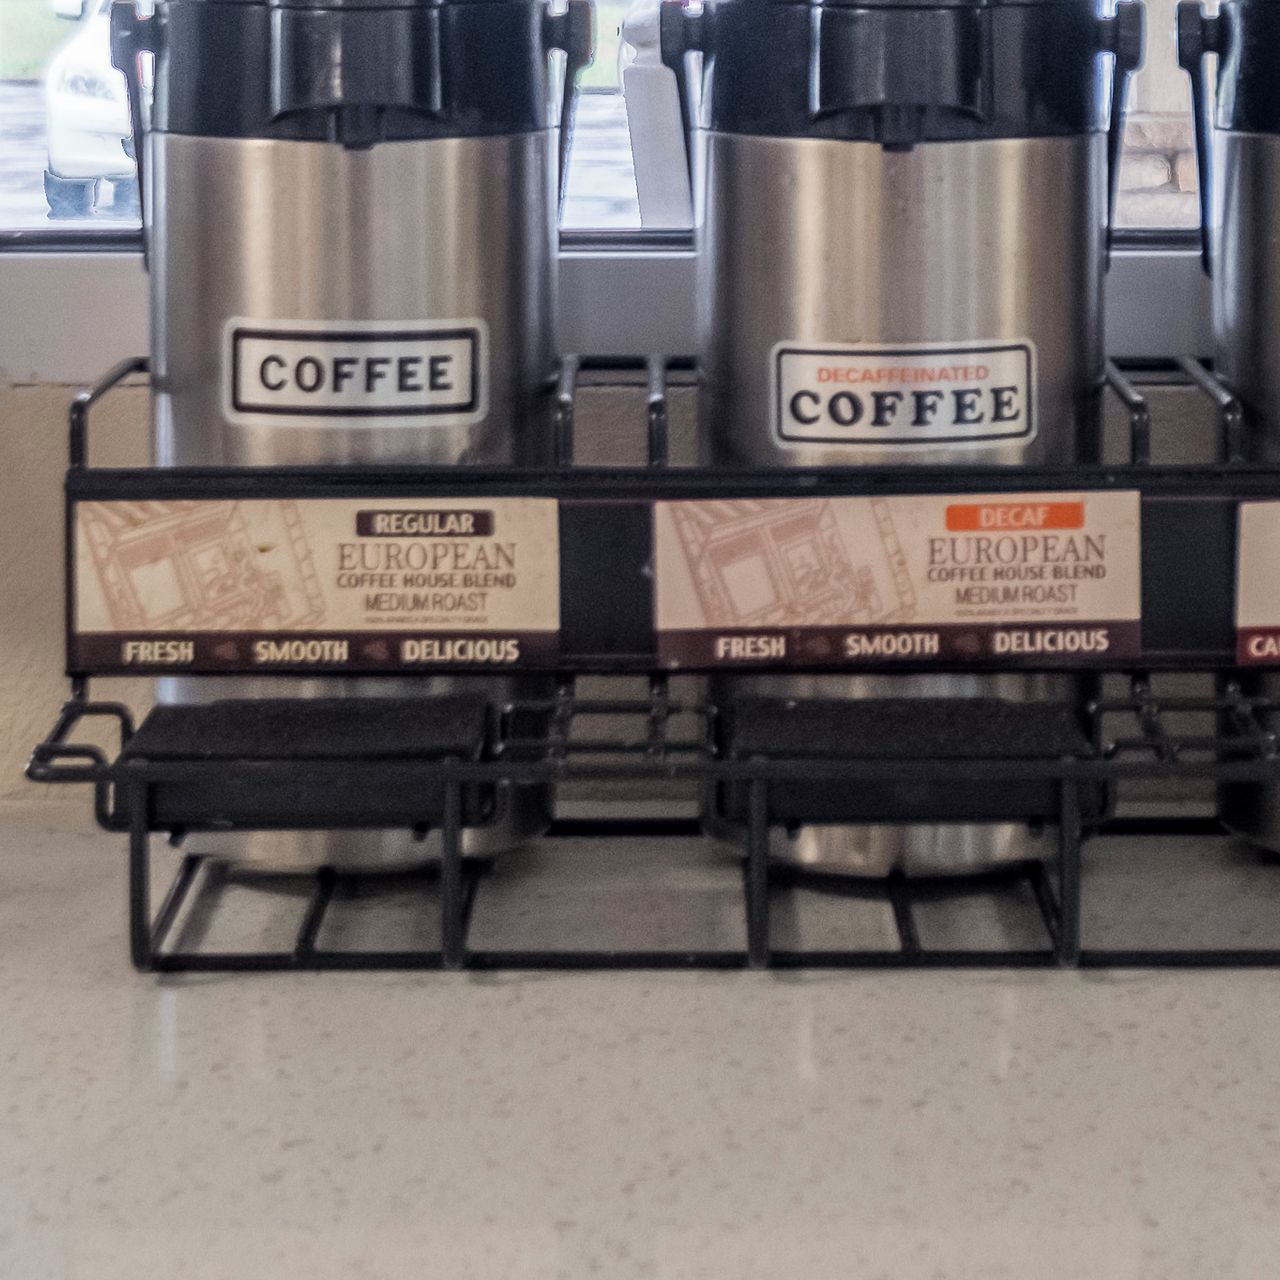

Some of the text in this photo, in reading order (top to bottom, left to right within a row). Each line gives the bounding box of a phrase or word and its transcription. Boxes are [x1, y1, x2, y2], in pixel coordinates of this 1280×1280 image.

[259, 354, 453, 393] COFFEE
[816, 365, 990, 384] DECAFFEINATED
[789, 385, 1021, 427] COFFEE
[375, 513, 475, 534] REGULAR
[979, 506, 1050, 528] DECAF
[337, 542, 518, 571] EUROPEAN
[927, 534, 1107, 565] EUROPEAN
[336, 573, 517, 589] COFFEE HOUSE BLEND
[927, 564, 1107, 582] COFFEE HOUSE BLEND
[365, 593, 488, 611] MEDIUM ROAST
[955, 584, 1078, 605] MEDIUM ROAST
[124, 639, 520, 664] FRESH SMOOTH DELICIOUS
[715, 630, 1110, 658] FRESH SMOOTH DELICIOUS
